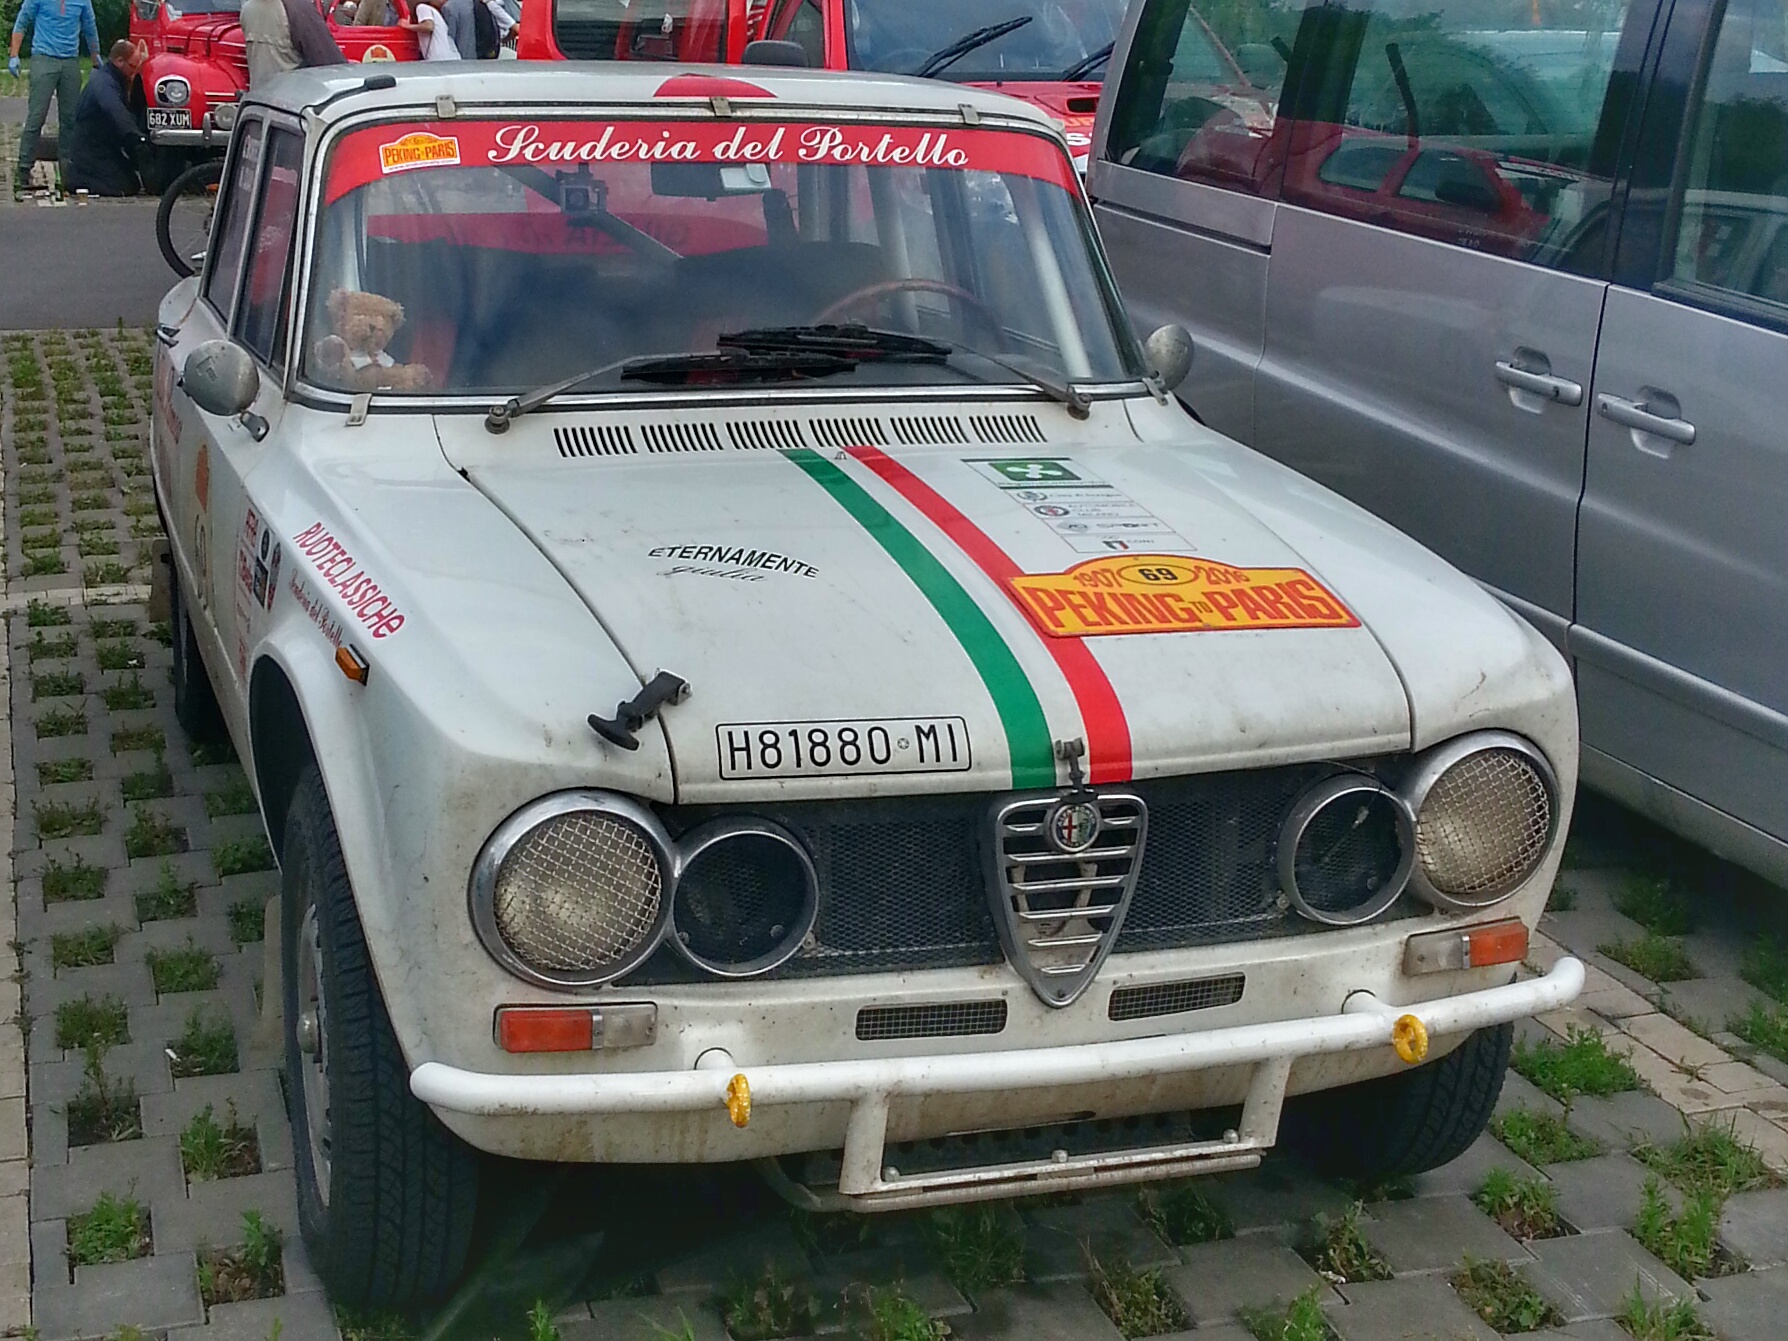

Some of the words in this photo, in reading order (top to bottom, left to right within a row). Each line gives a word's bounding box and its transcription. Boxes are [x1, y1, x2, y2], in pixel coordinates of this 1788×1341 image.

[150, 112, 168, 126] 682
[169, 113, 190, 126] XUM
[384, 147, 421, 165] PEKING
[425, 140, 456, 159] PARIS
[487, 125, 702, 163] Scuderia
[712, 126, 786, 160] del
[798, 126, 970, 167] Portello
[648, 545, 819, 579] ETERNAMENTE
[1073, 568, 1123, 588] 1907
[1138, 567, 1179, 582] 69
[1194, 565, 1251, 586] 2016
[1021, 585, 1202, 628] PEKING
[1201, 579, 1342, 622] PARIS
[727, 725, 892, 772] H81880
[915, 722, 958, 764] MI
